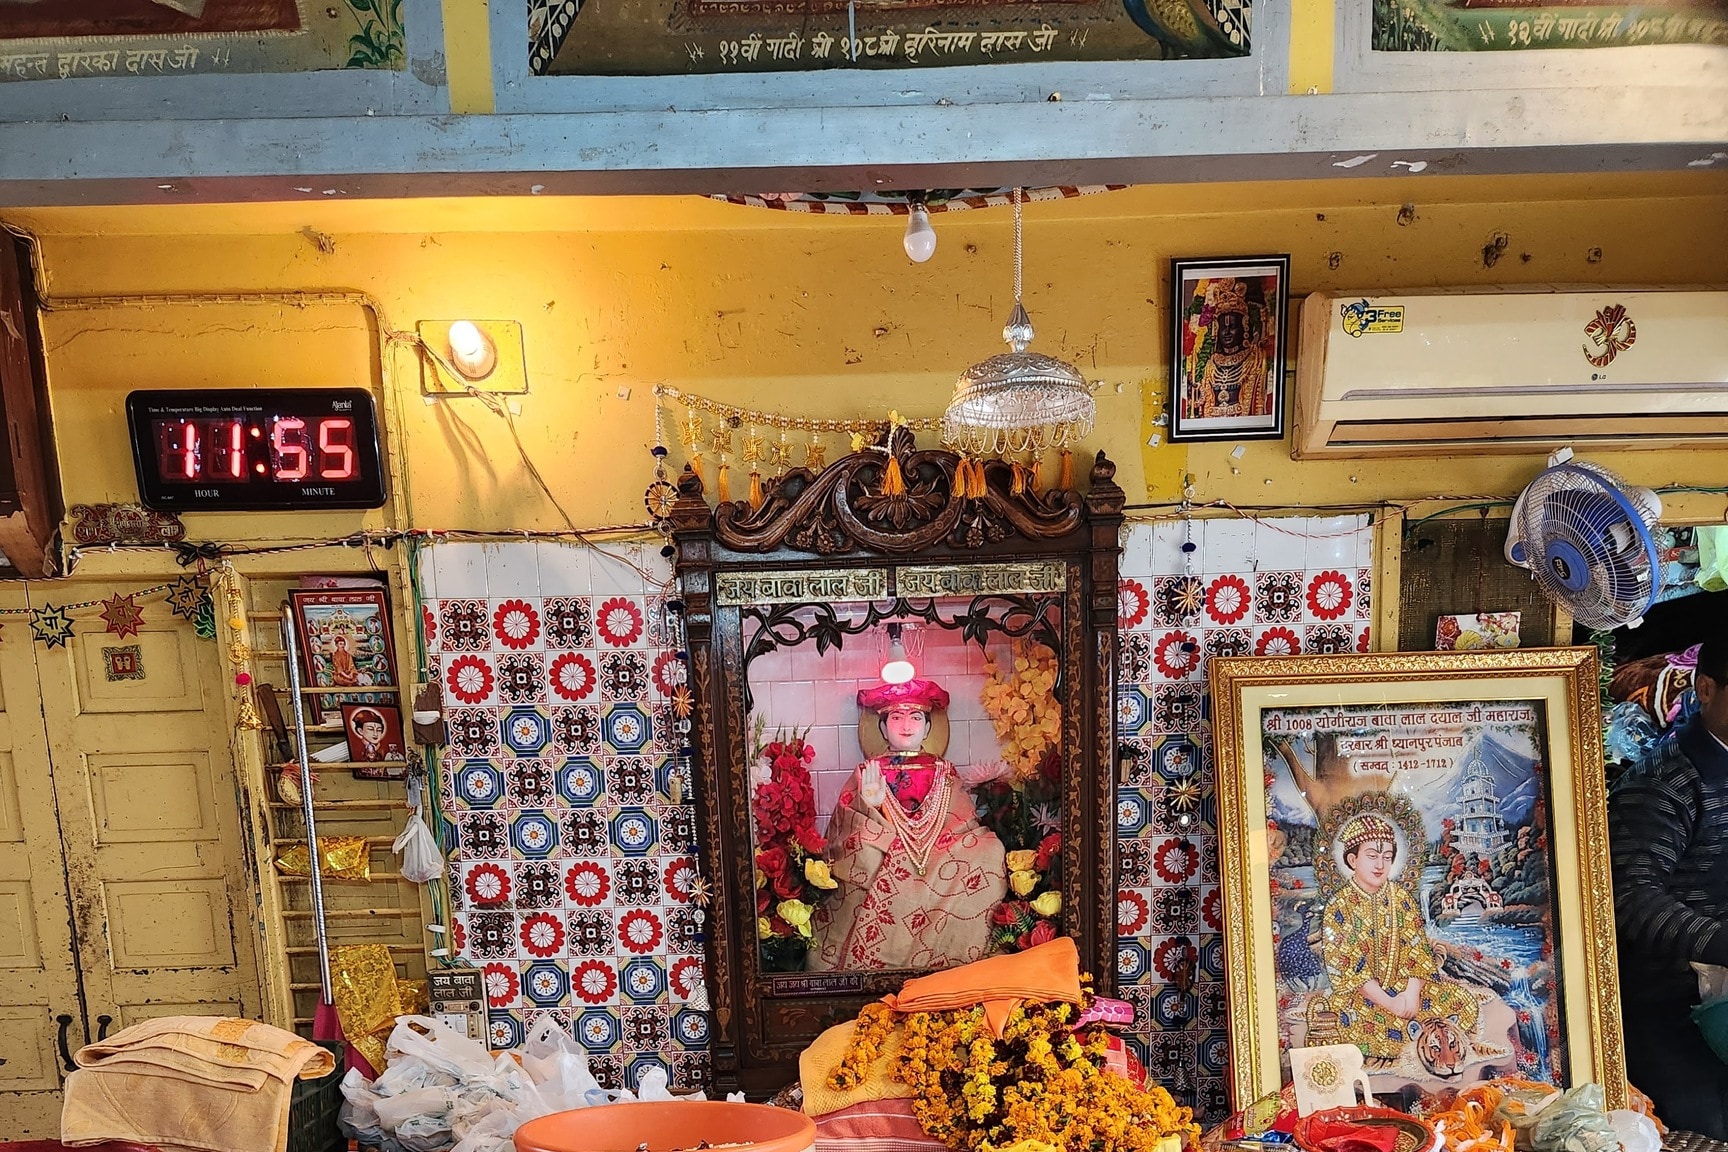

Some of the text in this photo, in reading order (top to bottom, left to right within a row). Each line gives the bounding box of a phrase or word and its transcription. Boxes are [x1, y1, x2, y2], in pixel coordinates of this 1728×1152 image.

[719, 33, 762, 65] ११वीं
[766, 32, 804, 60] गादी
[811, 31, 834, 59] श्री
[981, 32, 1027, 58] दास
[1027, 24, 1058, 52] जी
[1377, 309, 1402, 318] Free
[183, 419, 353, 479] 11:55
[194, 489, 220, 498] HOUR
[302, 487, 336, 496] MINUTE
[723, 578, 757, 599] जय
[807, 576, 849, 597] लाल
[853, 571, 883, 597] जी
[903, 572, 936, 593] जय
[986, 571, 1027, 591] लाल
[1029, 566, 1058, 591] जी
[1266, 714, 1282, 731] श्री
[1286, 719, 1313, 731] 1008
[1315, 712, 1369, 729] योगीराज
[1371, 714, 1397, 727] बावा
[1400, 712, 1427, 726] लाल
[1429, 711, 1463, 725] दयाल
[1466, 707, 1484, 723] जी
[1375, 736, 1389, 750] श्री
[1434, 734, 1463, 748] पंजाब
[432, 975, 475, 986] जय बावा
[433, 985, 474, 998] लाल जी
